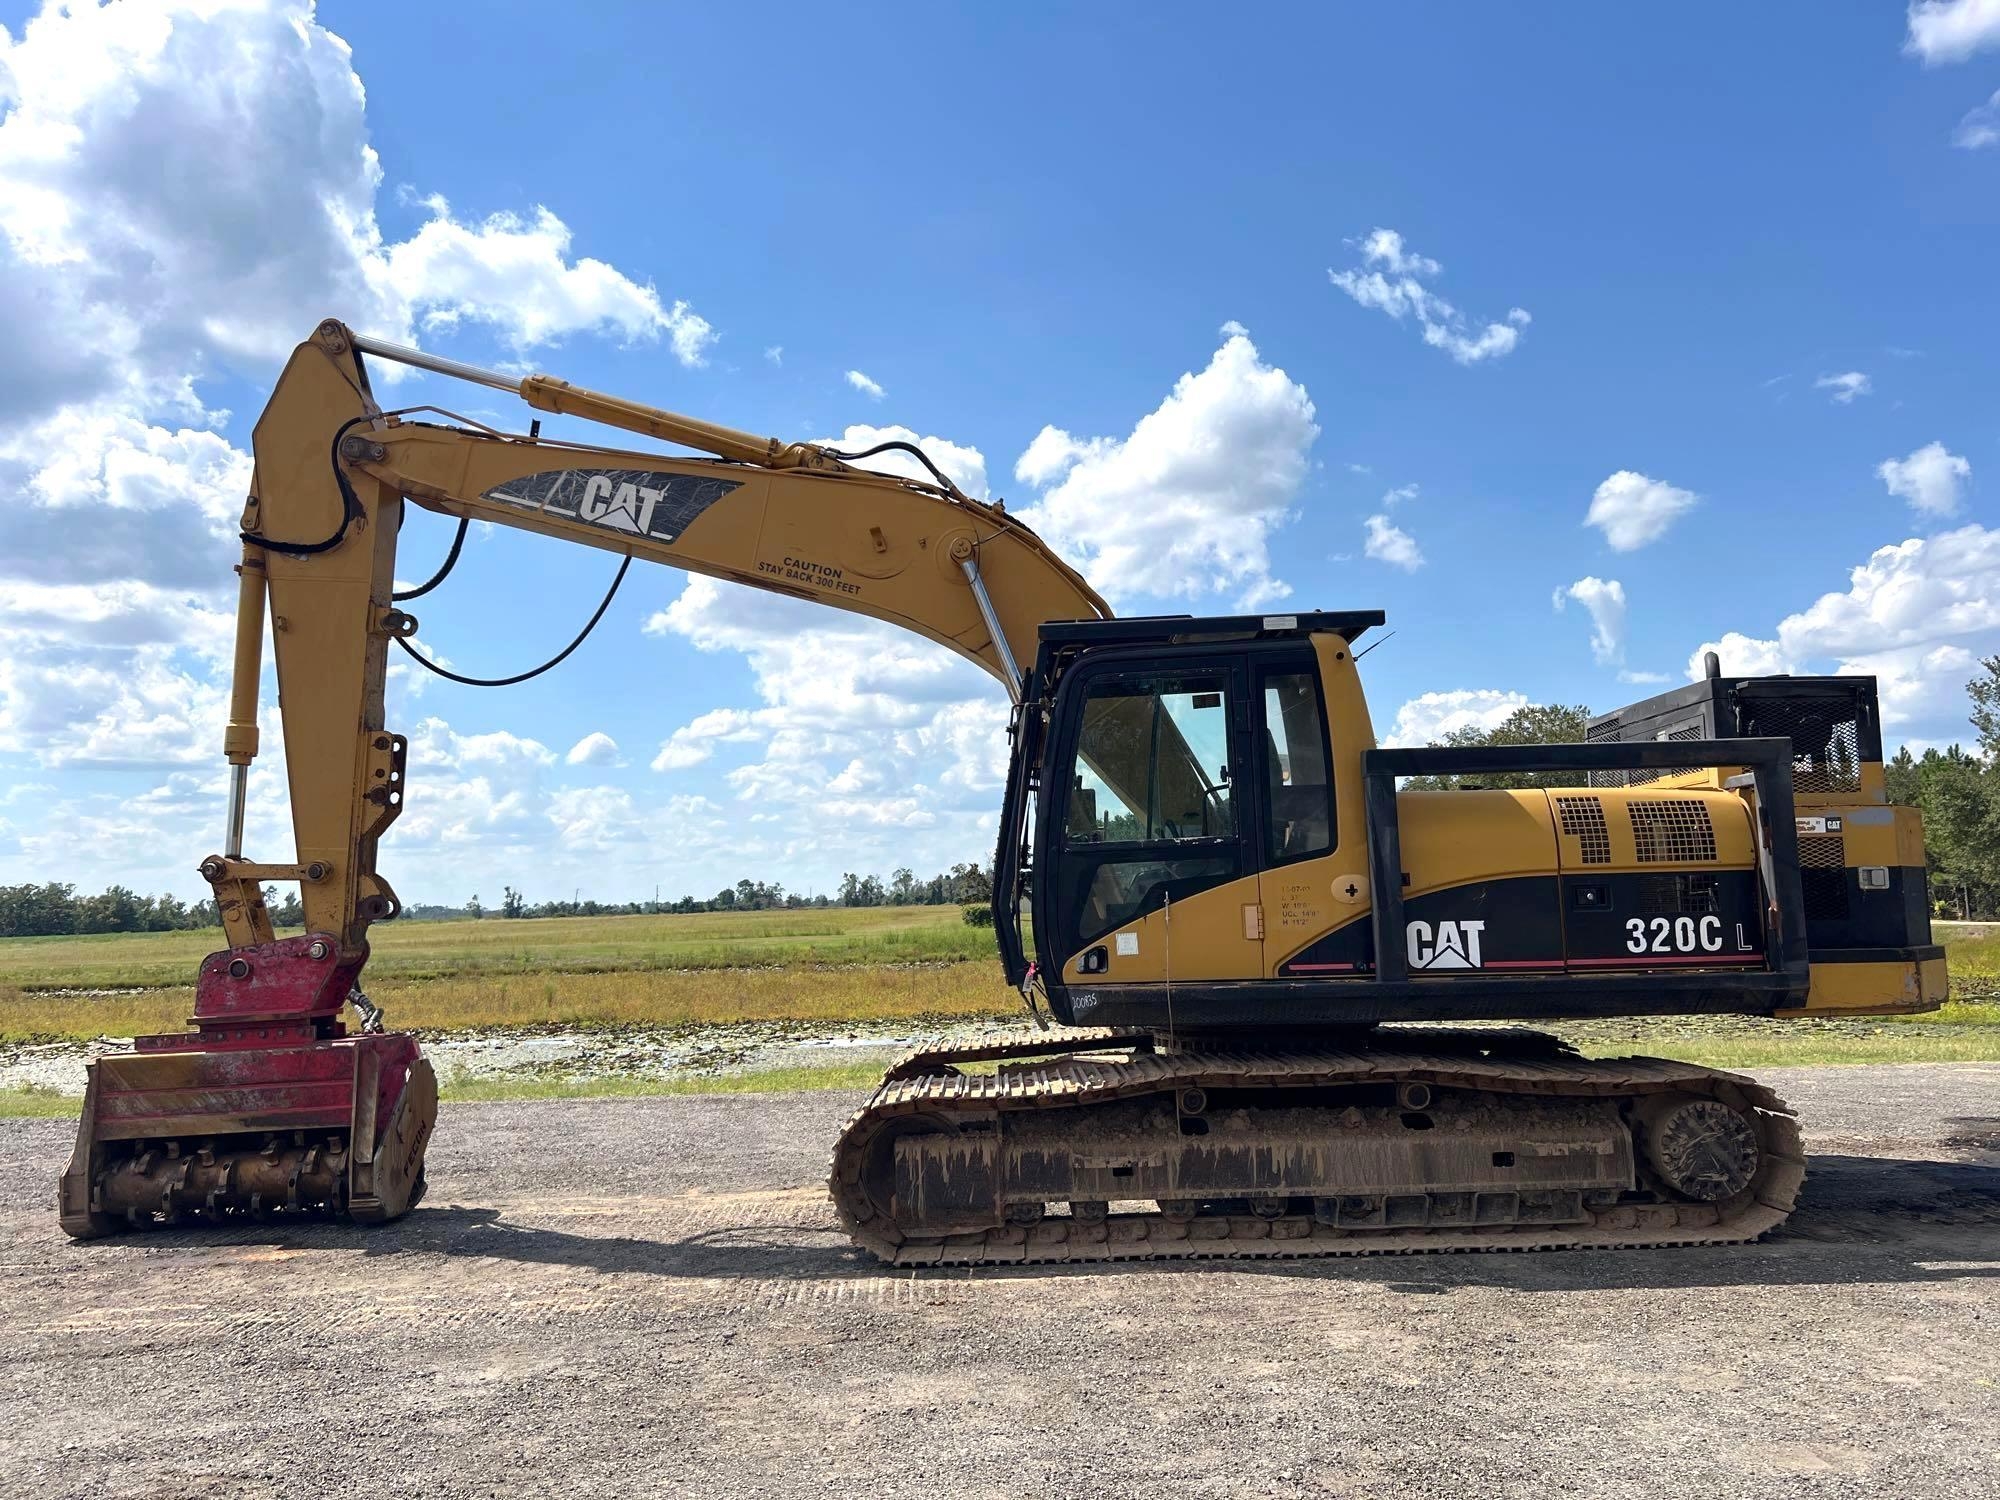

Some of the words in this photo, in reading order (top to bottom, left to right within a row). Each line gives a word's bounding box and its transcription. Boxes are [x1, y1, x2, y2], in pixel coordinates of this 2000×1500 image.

[580, 475, 664, 535] CAT
[758, 561, 783, 575] STAY
[786, 569, 813, 583] BACK
[815, 576, 834, 588] 300
[835, 581, 862, 595] FEET
[783, 557, 842, 579] CAUTION
[1827, 820, 1841, 829] CAT
[1406, 920, 1485, 969] CAT
[1626, 915, 1722, 953] 320C
[1736, 923, 1752, 950] L
